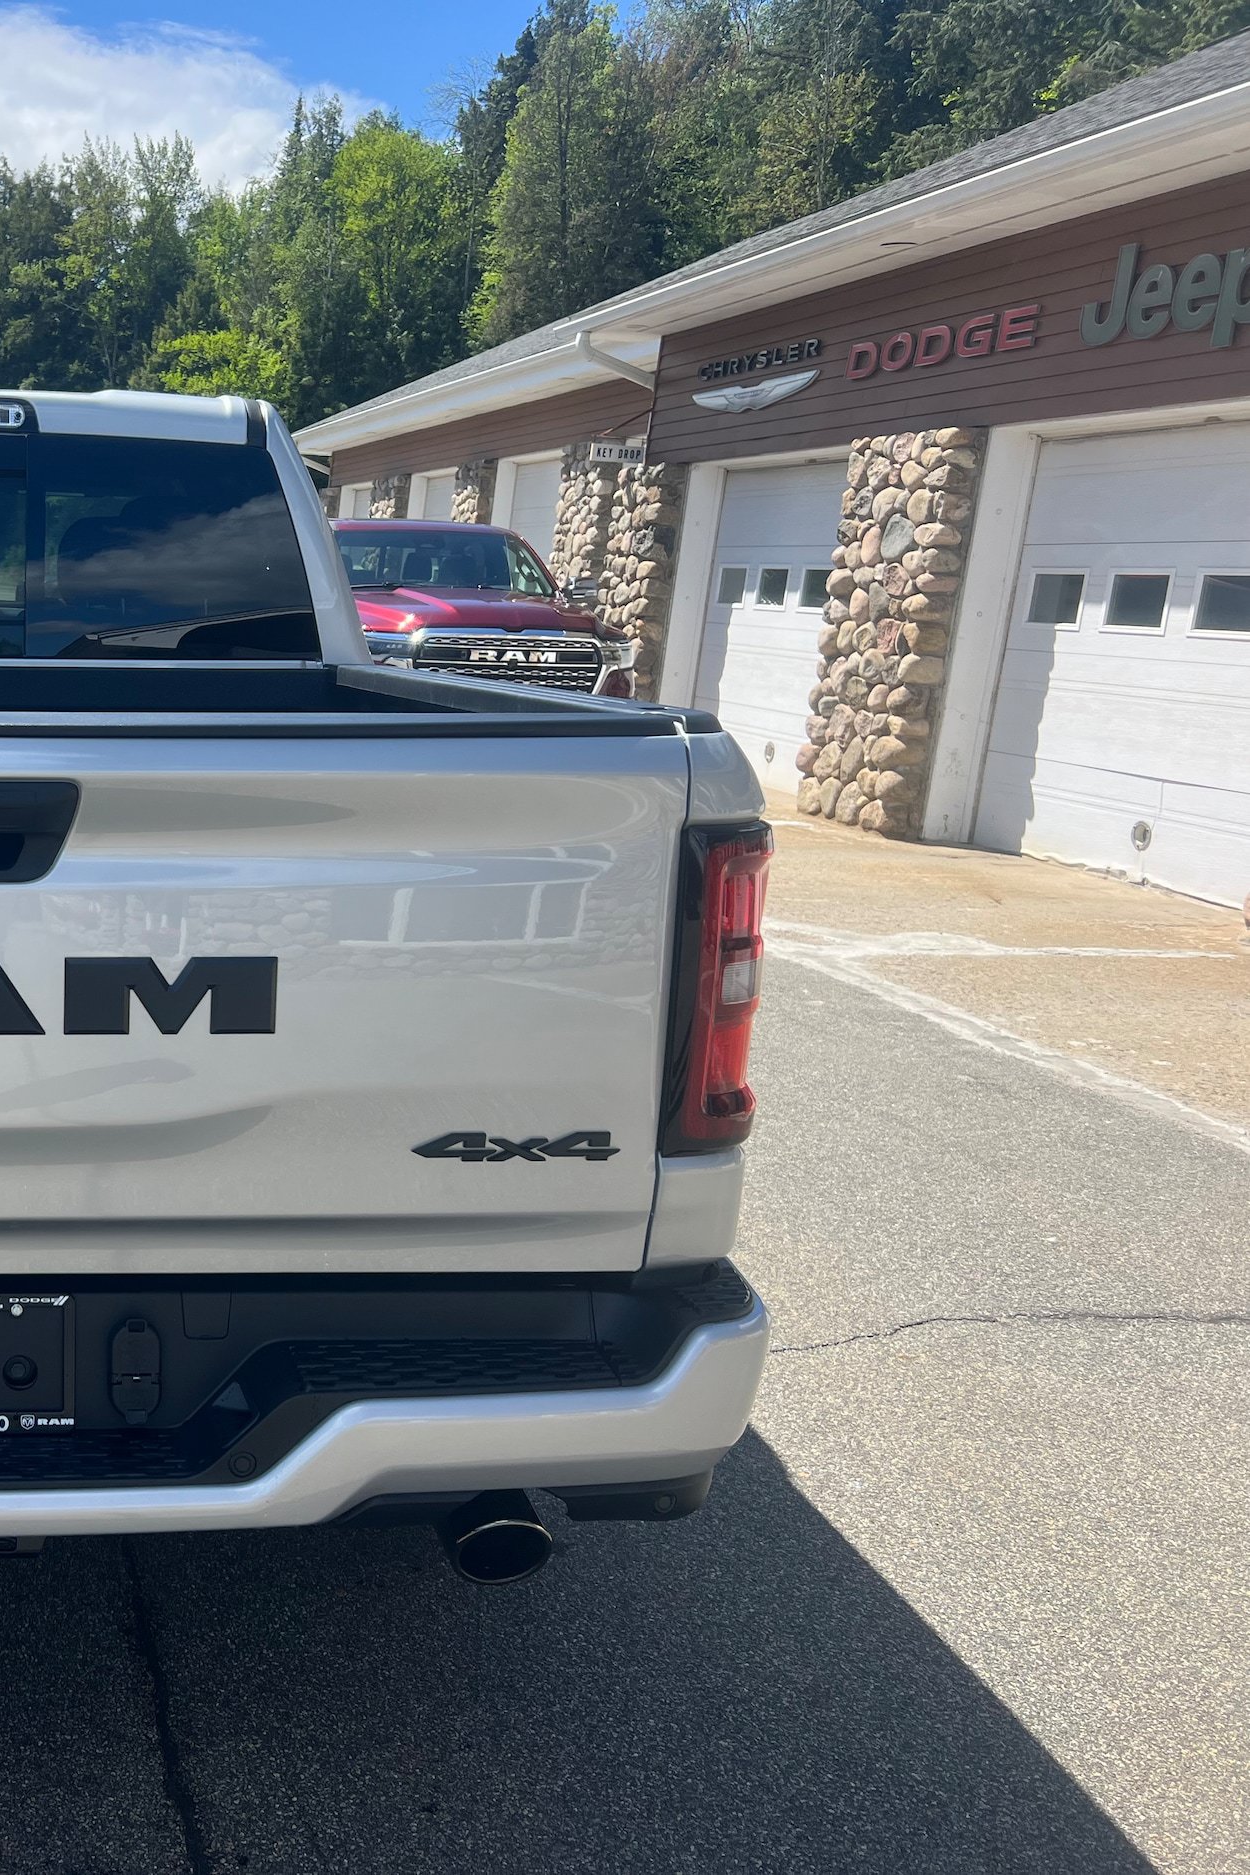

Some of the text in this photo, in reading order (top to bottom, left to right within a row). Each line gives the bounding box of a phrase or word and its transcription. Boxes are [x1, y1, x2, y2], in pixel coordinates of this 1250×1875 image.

[845, 304, 1043, 380] DODGE
[698, 338, 822, 381] CHRYSLER
[596, 447, 641, 460] KEY DROP
[468, 649, 557, 663] RAM
[411, 1130, 622, 1162] 4x4
